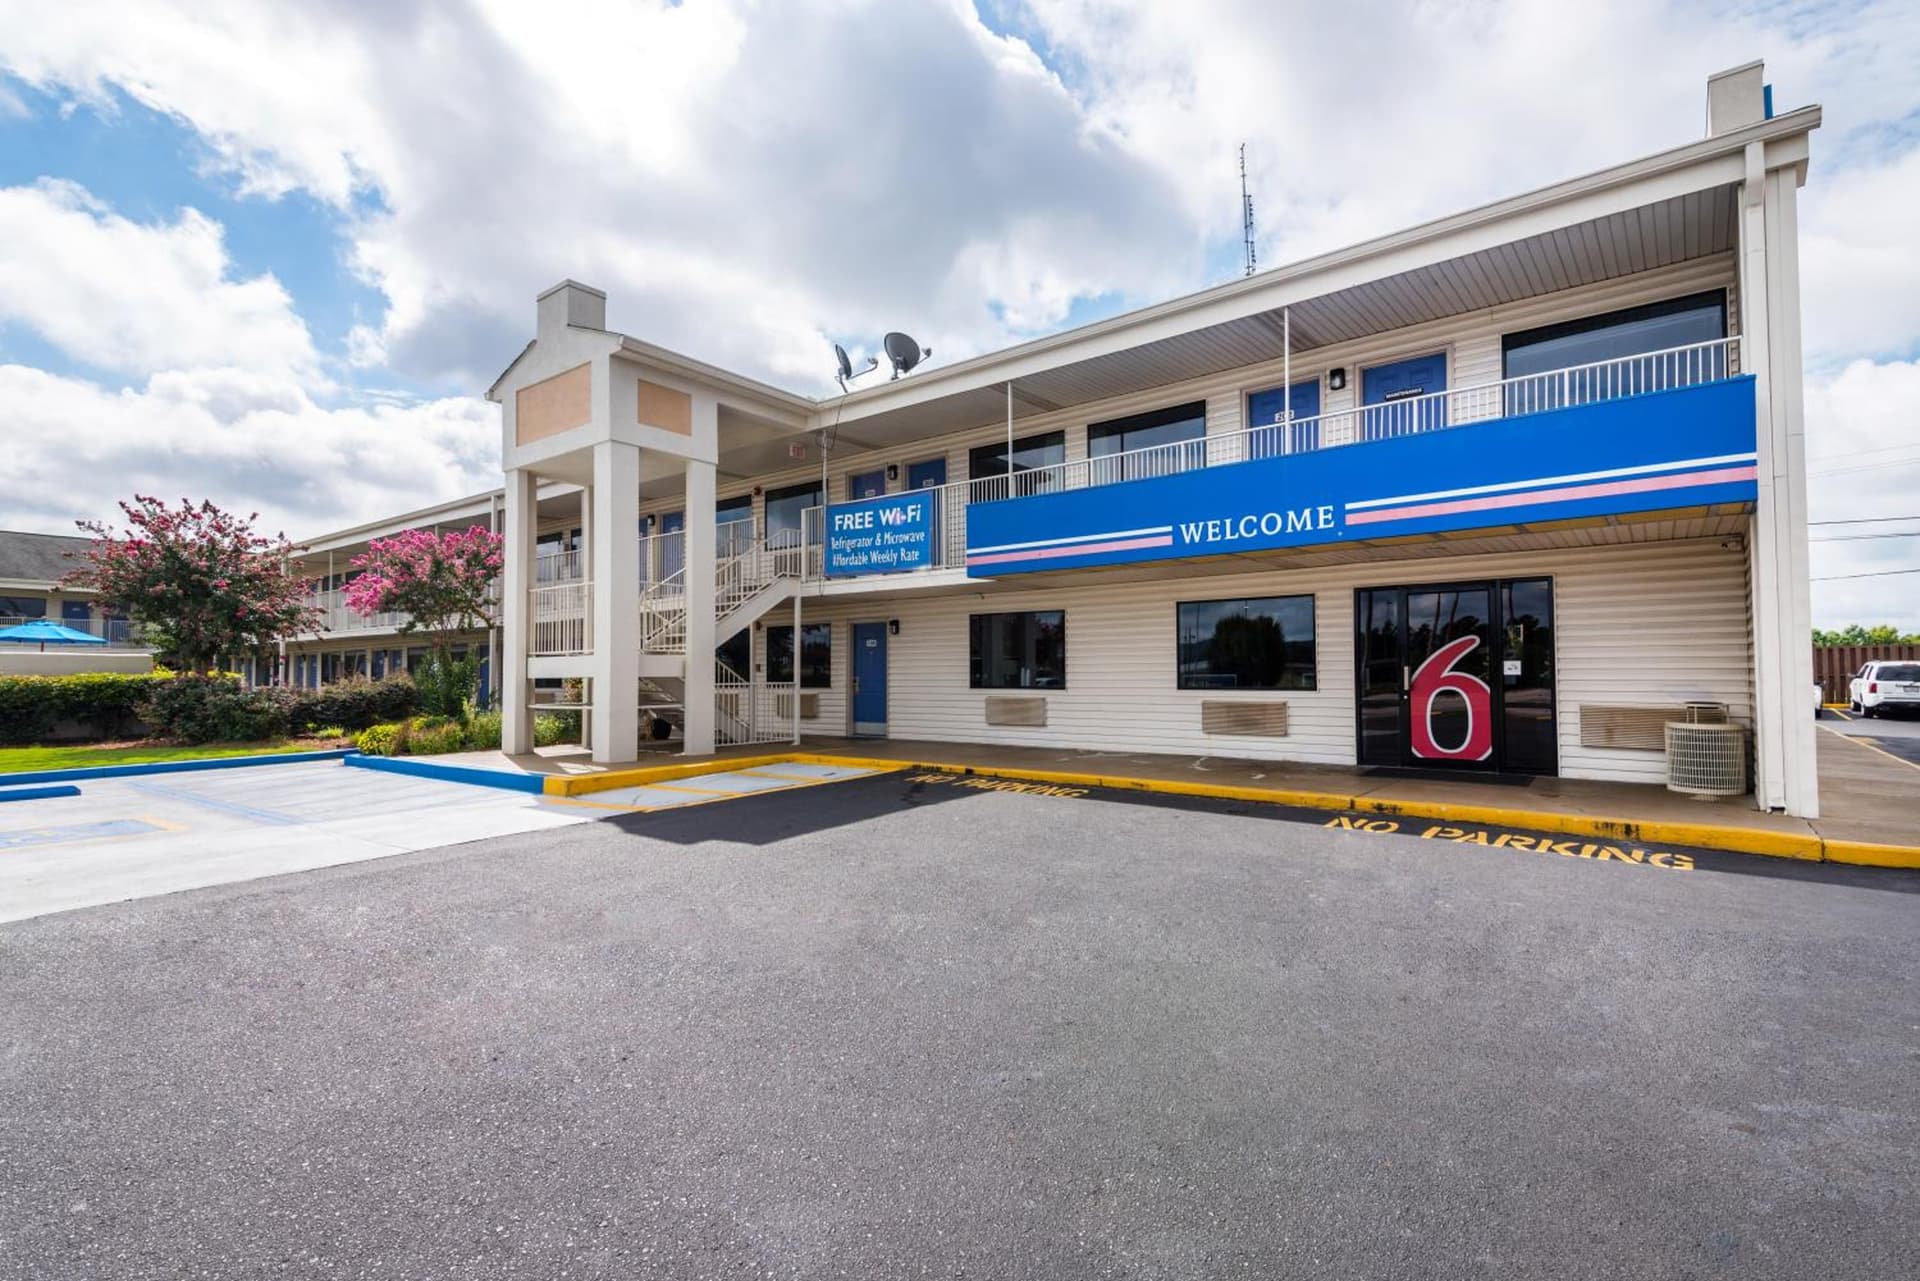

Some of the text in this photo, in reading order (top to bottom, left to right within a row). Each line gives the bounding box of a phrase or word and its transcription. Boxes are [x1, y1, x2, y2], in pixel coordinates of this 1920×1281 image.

[834, 504, 922, 531] FREE Wi-Fi
[1179, 505, 1335, 544] WELCOME
[831, 531, 925, 552] Refrigerator & Microwave
[832, 549, 920, 567] Affordable Weekly Rate
[1409, 634, 1493, 761] 6
[1323, 816, 1696, 871] NO PARKING
